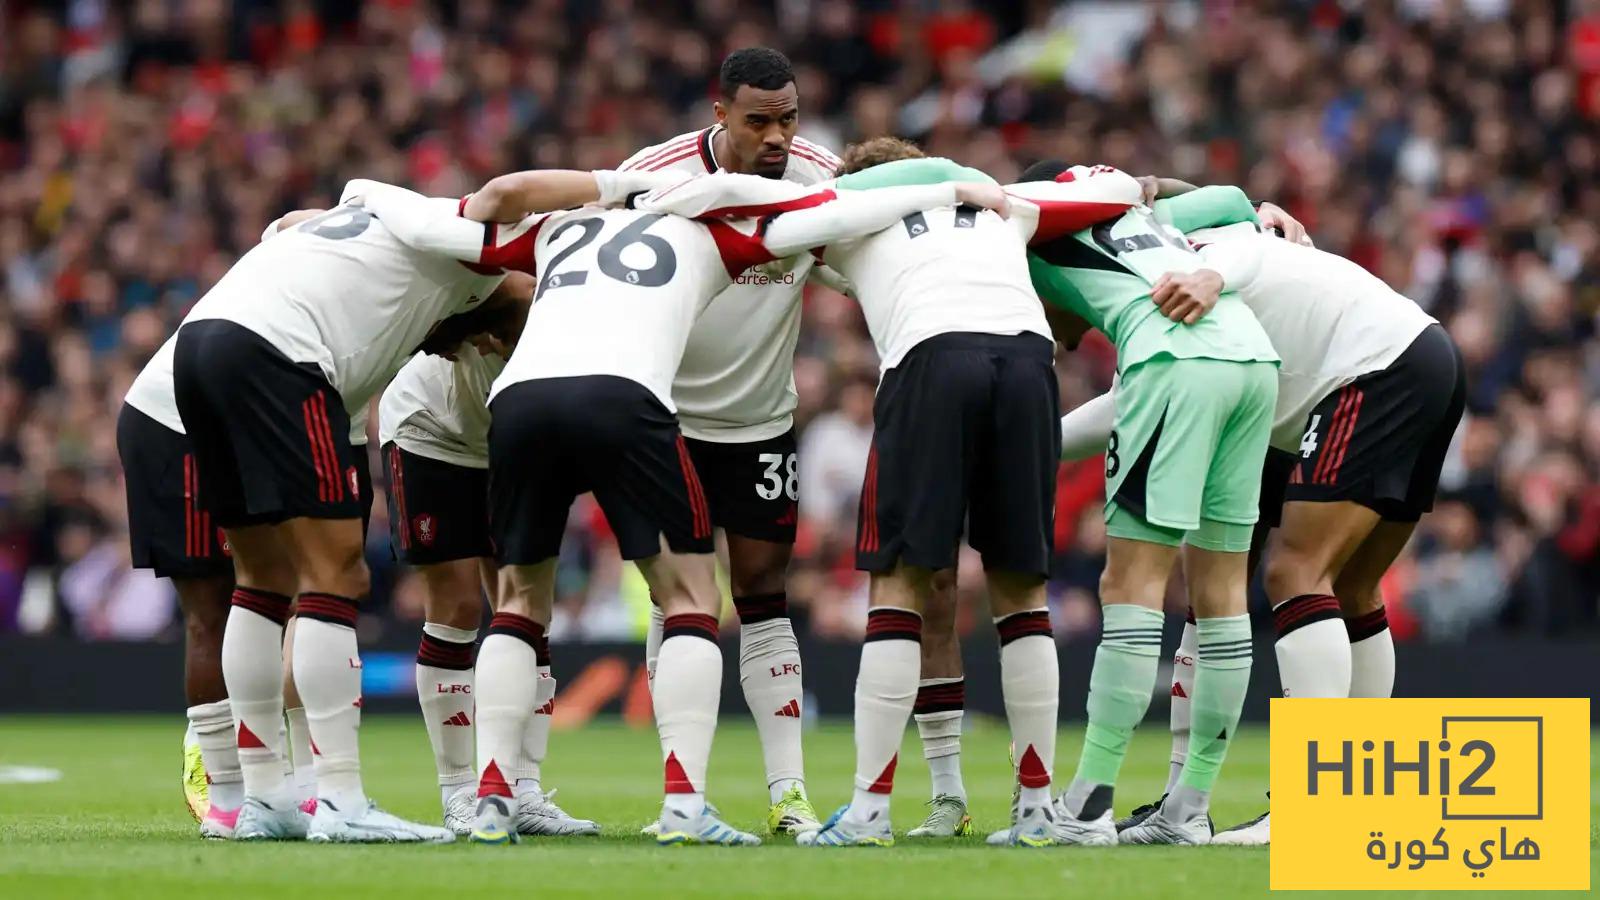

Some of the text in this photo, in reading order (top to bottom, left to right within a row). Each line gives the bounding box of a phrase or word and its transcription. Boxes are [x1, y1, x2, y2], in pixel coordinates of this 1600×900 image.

[534, 213, 677, 303] 26
[732, 272, 794, 286] arted
[1299, 414, 1321, 458] 4
[755, 453, 800, 501] 38
[769, 663, 800, 677] LFC
[437, 683, 471, 694] LFC
